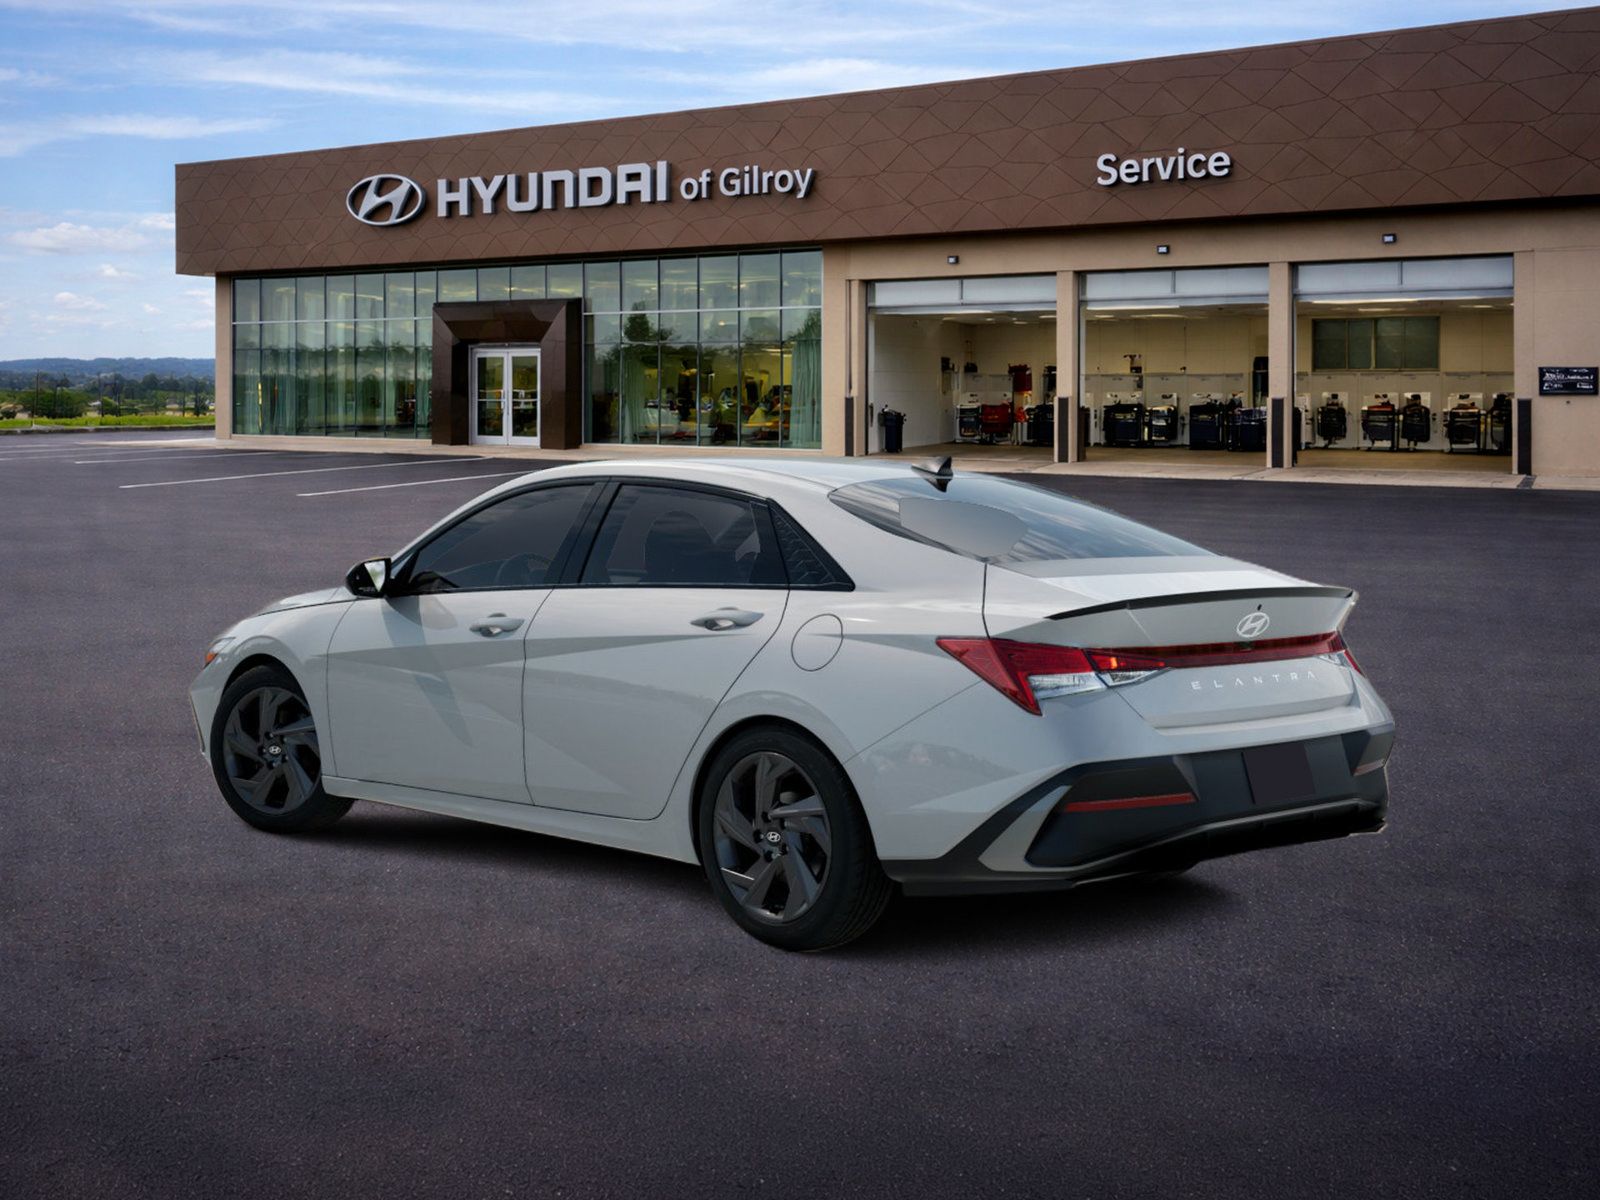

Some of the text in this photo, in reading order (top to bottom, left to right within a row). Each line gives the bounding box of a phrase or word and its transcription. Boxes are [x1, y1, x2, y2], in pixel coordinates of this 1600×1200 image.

[1096, 147, 1231, 186] Service
[436, 160, 813, 218] HYUNDAI of Gilroy
[1190, 670, 1317, 691] ELANTRA
